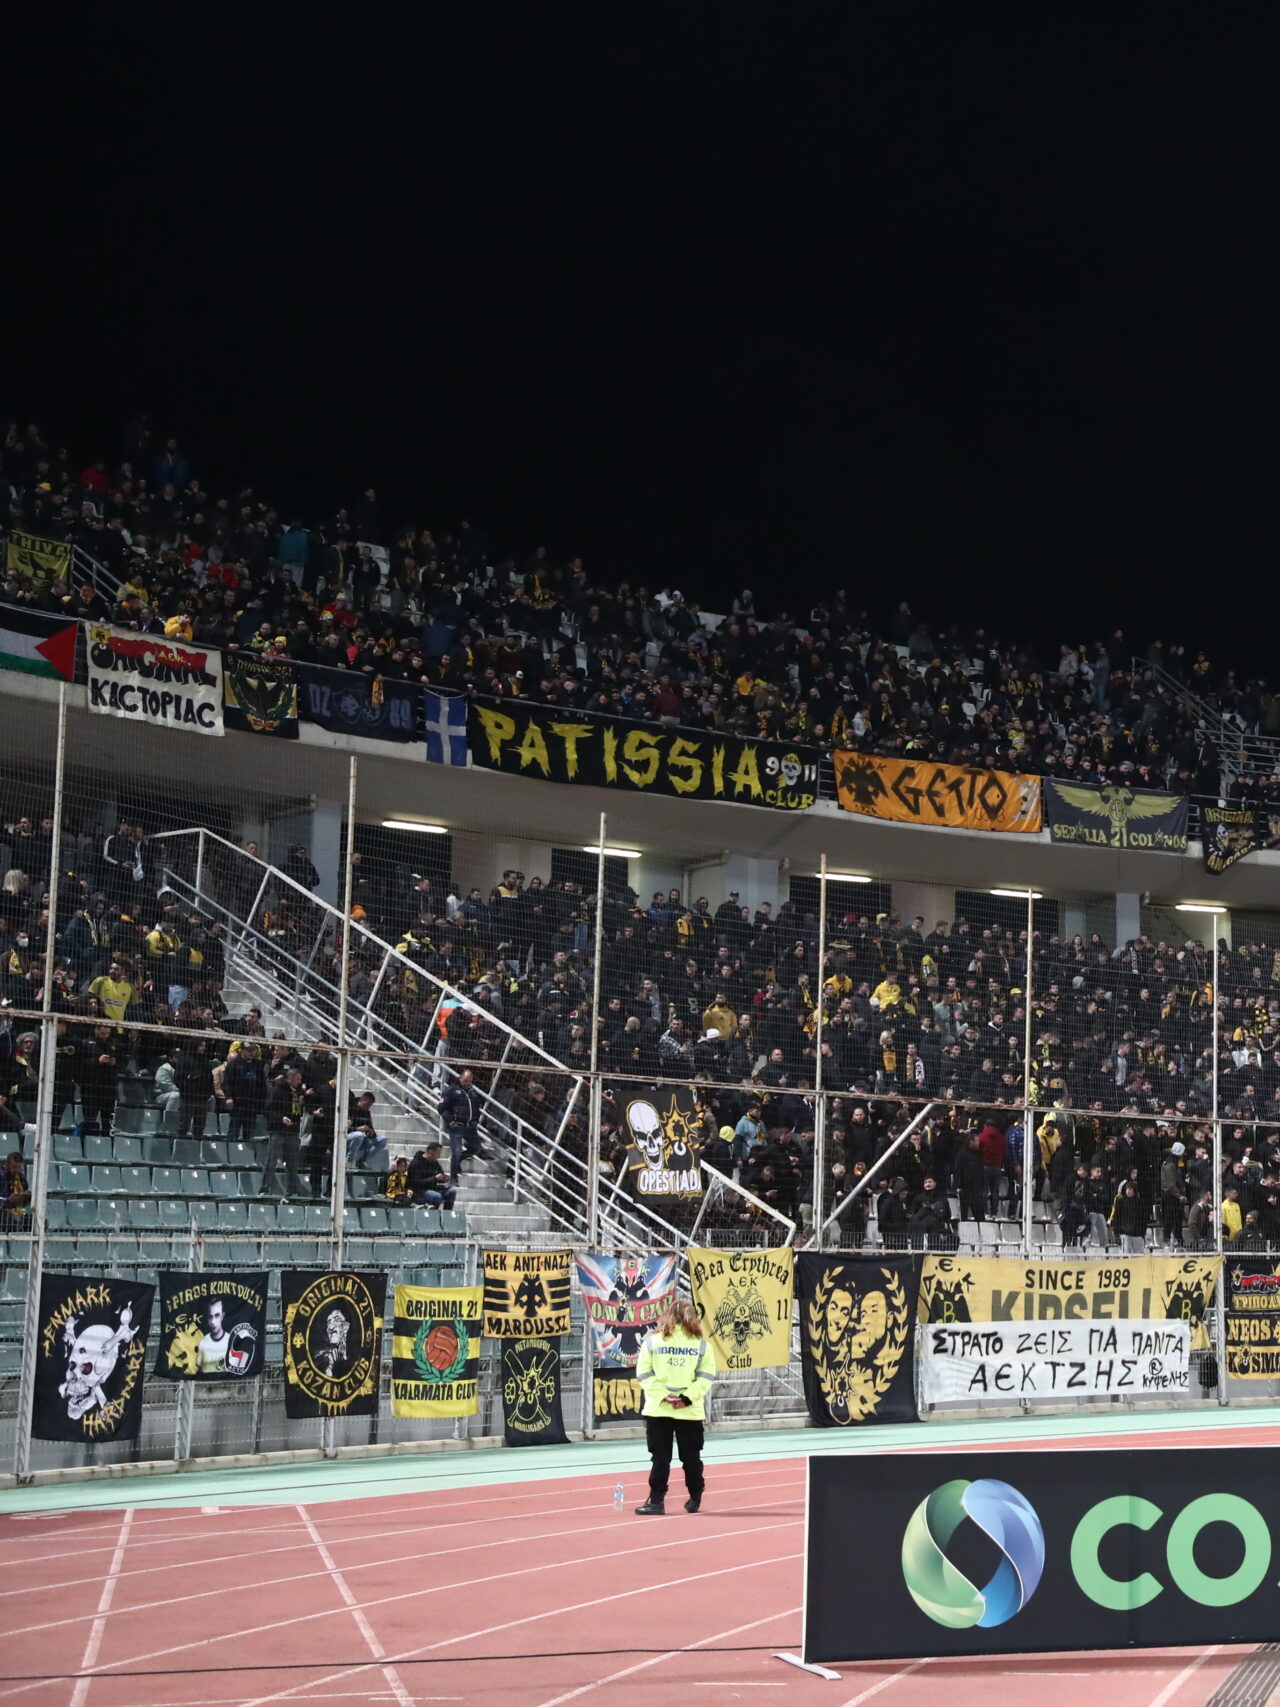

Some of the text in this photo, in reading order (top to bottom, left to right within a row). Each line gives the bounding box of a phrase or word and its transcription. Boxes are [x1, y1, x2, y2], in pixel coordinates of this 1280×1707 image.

[473, 704, 764, 799] PATISSIA
[765, 789, 816, 809] CLUB
[891, 767, 1007, 821] GETTO
[1111, 826, 1127, 847] 21
[485, 1255, 507, 1270] AEK
[1025, 1269, 1131, 1290] SINCE 1989
[300, 1277, 358, 1317] ORIGINAL
[406, 1300, 478, 1318] ORIGINAL 21
[488, 1316, 568, 1335] MAROUSSI
[1227, 1318, 1270, 1341] NEOS
[661, 1346, 699, 1356] BRINKS
[933, 1329, 1003, 1357] ΣΤΡΑΤΟ
[1132, 1328, 1184, 1363] ΠΑΝΤΑ
[667, 1357, 685, 1367] 432
[727, 1355, 752, 1369] Club
[594, 1378, 645, 1416] KIAT
